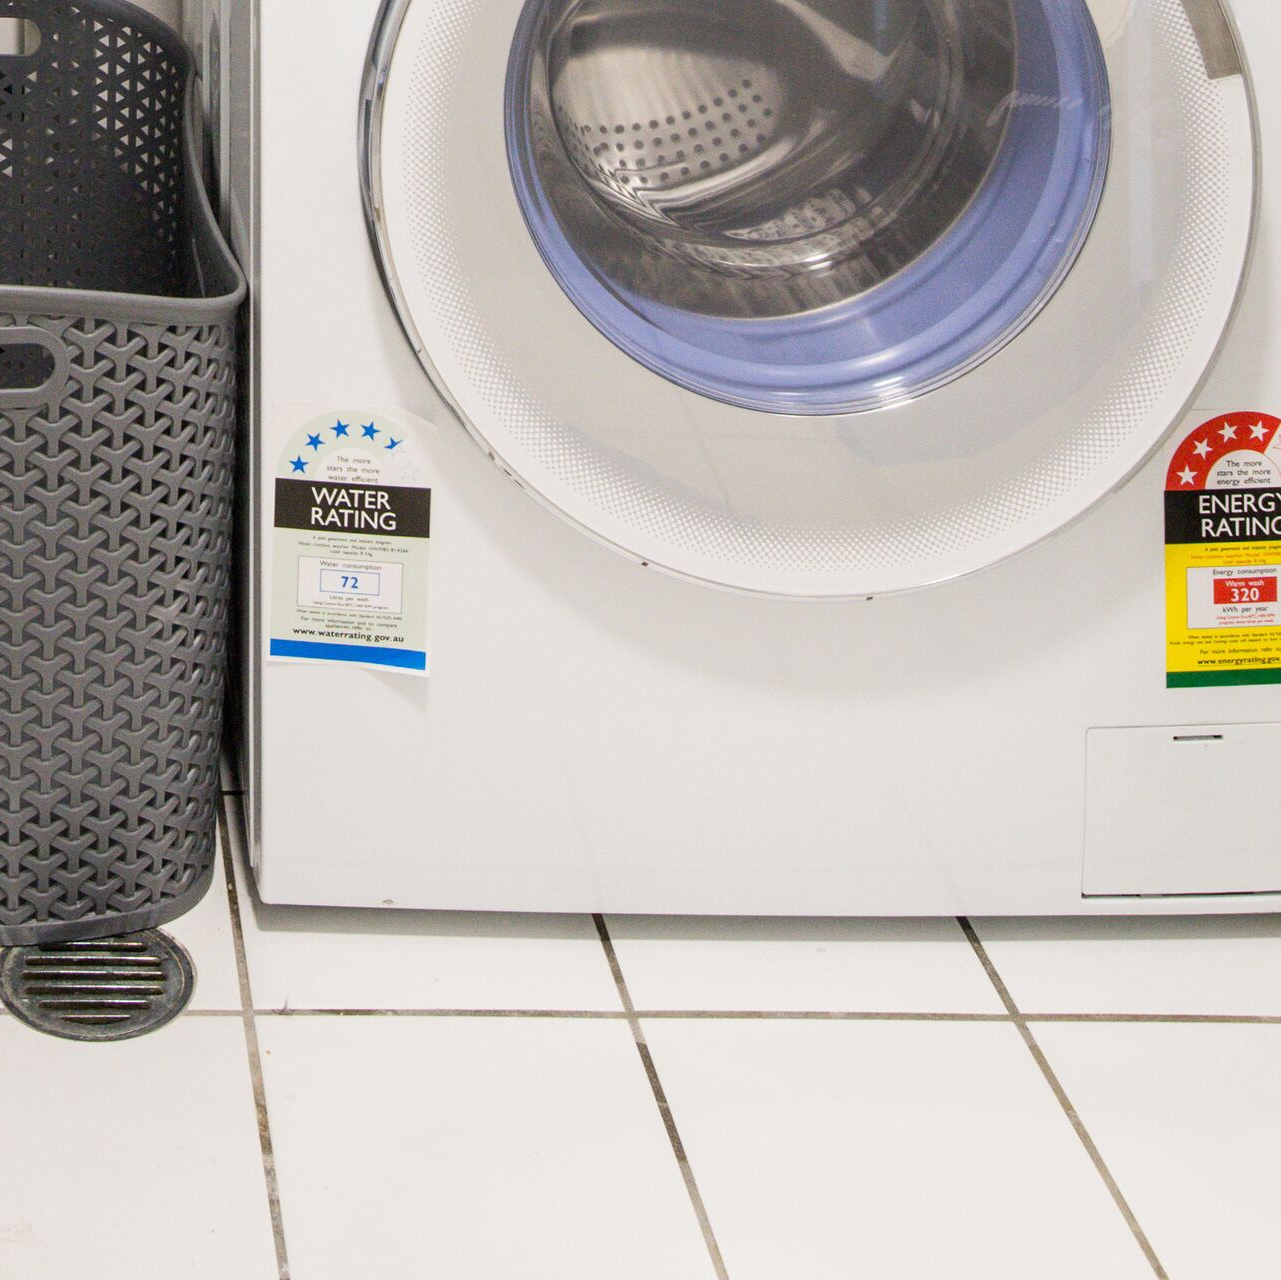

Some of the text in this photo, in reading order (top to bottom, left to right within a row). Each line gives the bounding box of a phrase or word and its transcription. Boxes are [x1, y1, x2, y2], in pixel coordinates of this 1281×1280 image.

[336, 455, 349, 464] The
[1226, 460, 1240, 468] The
[326, 465, 343, 473] stars
[346, 465, 358, 474] the
[328, 474, 379, 484] water efficient
[1216, 476, 1271, 487] energy efficient
[311, 487, 391, 511] WATER
[310, 506, 397, 531] RATING
[320, 560, 382, 571] Water consumption
[1237, 567, 1277, 575] consumption
[341, 576, 359, 589] 72
[1231, 588, 1259, 601] 320
[1255, 606, 1268, 614] year
[293, 627, 404, 642] www.waterrating.gov.au
